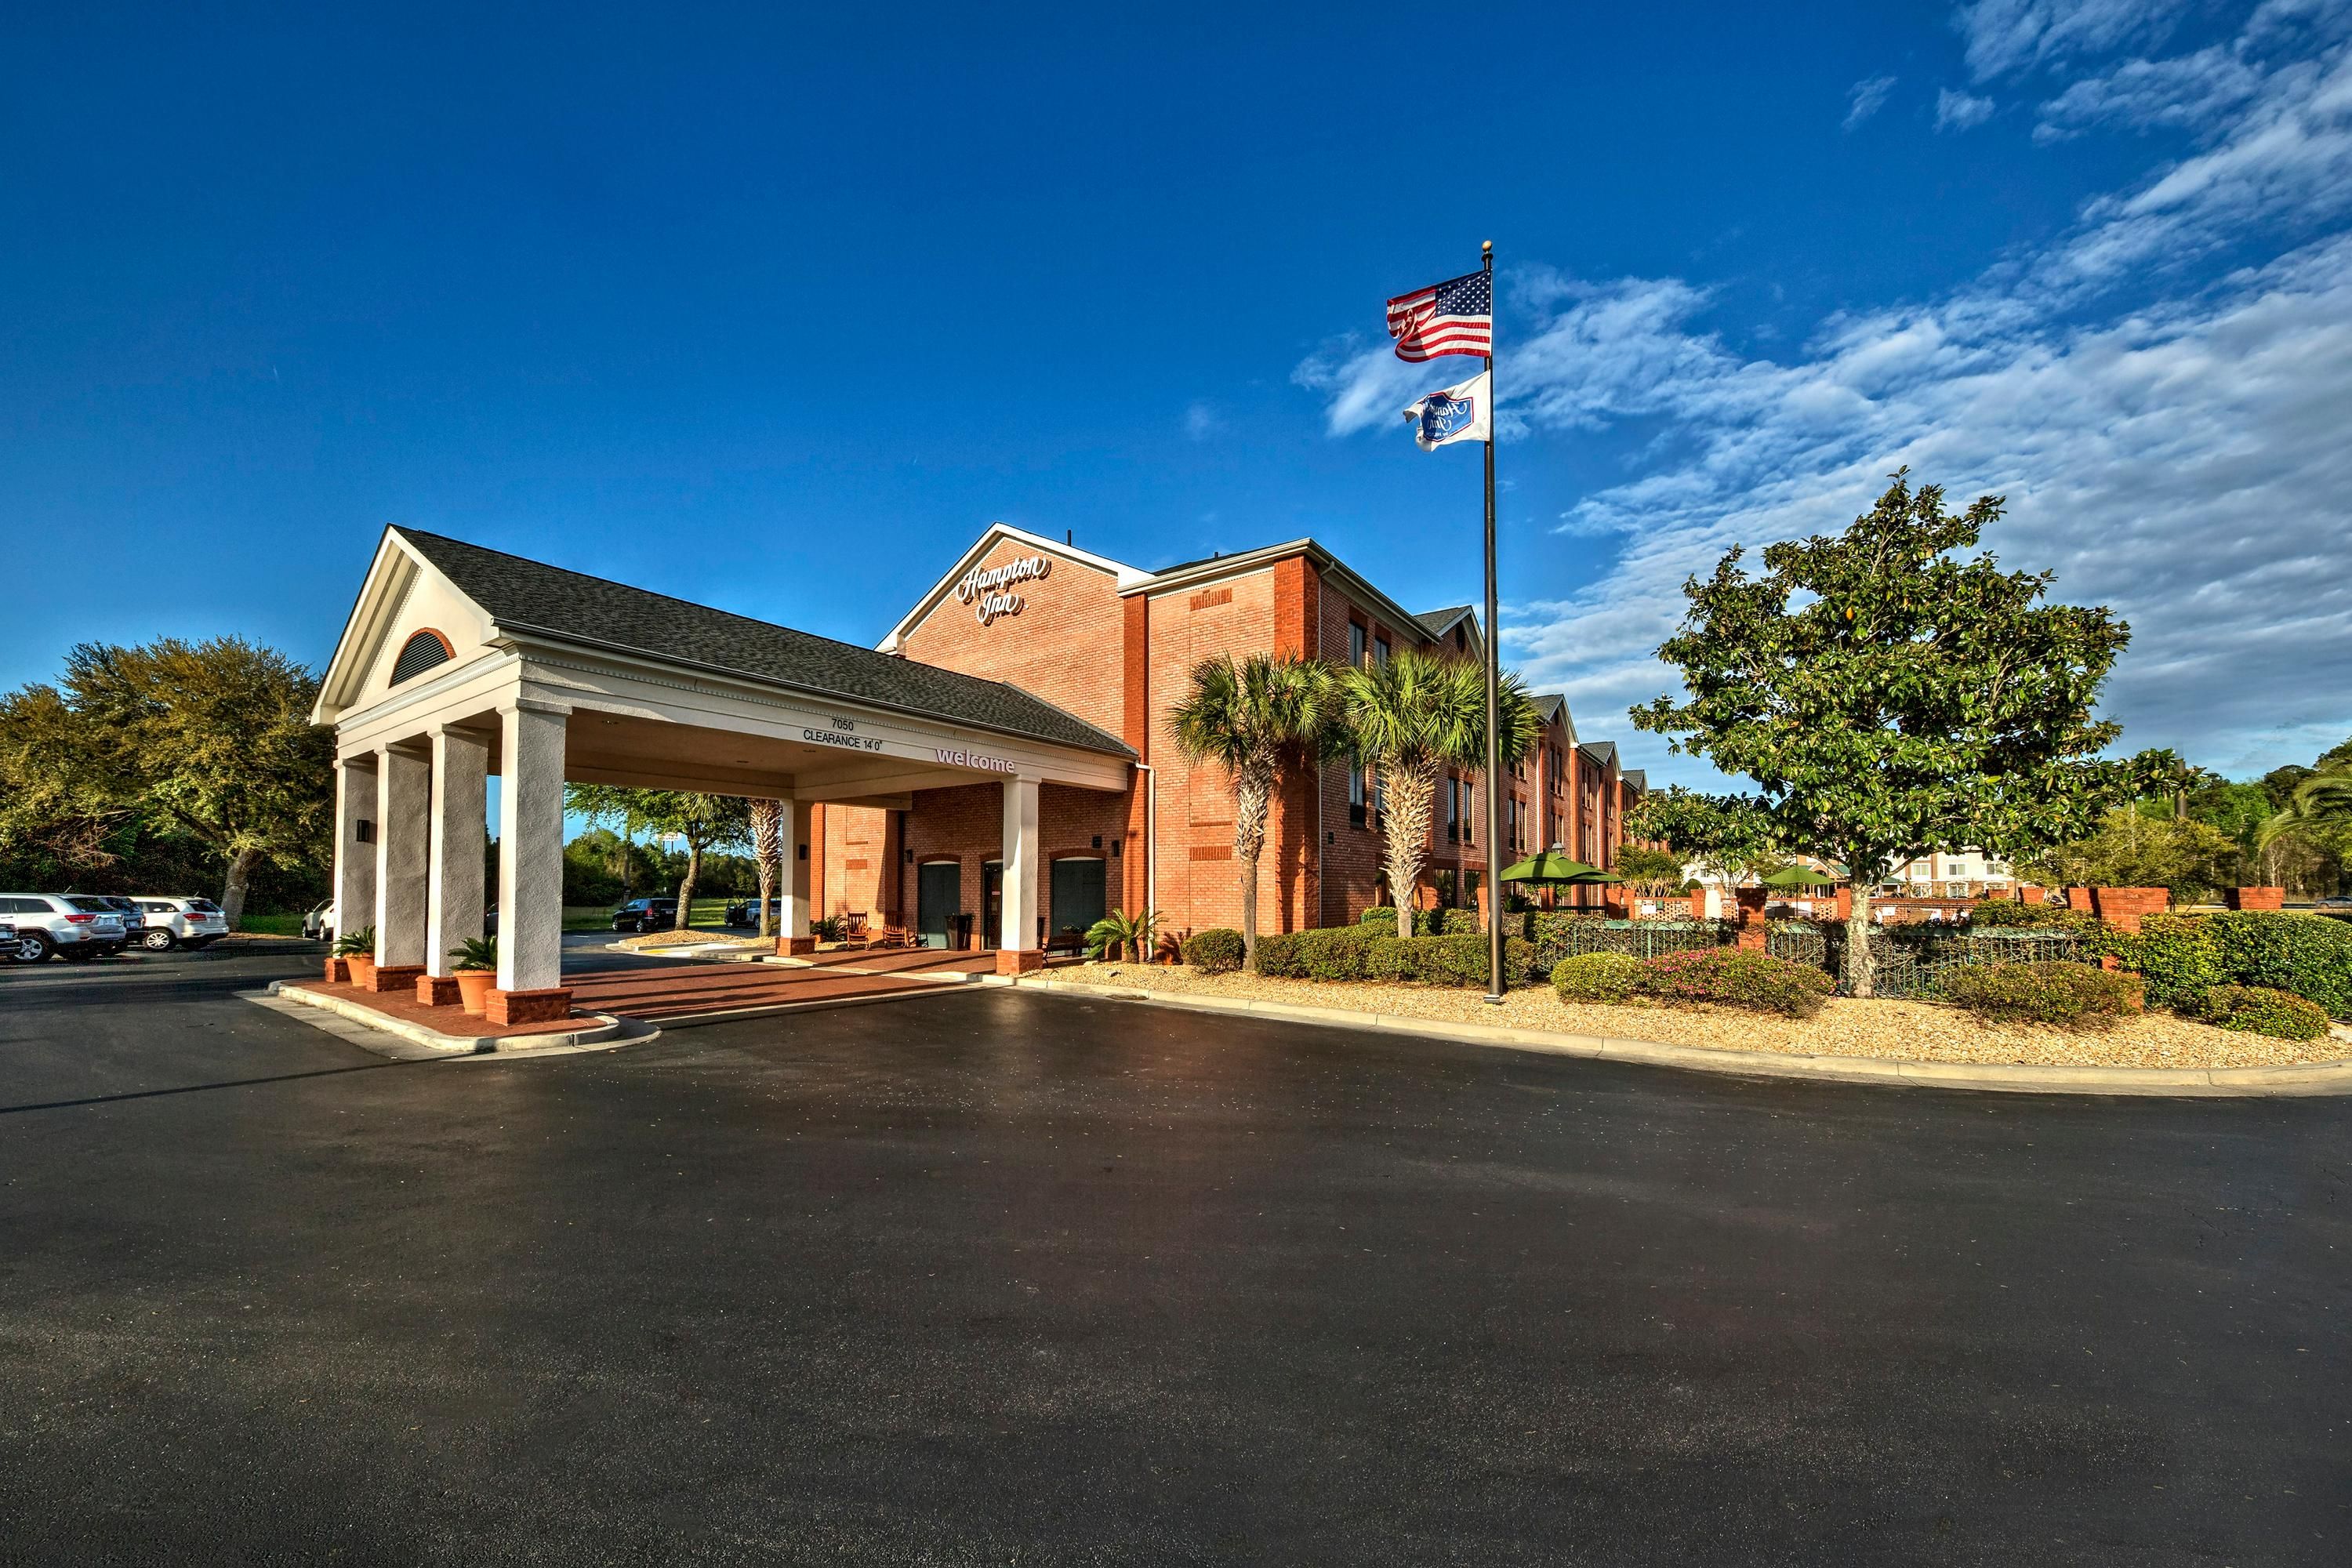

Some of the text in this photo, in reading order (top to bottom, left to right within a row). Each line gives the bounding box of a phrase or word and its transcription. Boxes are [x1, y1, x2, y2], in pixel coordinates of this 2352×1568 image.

[956, 557, 1051, 601] Hampton
[976, 591, 1022, 623] Inn
[832, 718, 854, 731] 7050
[804, 729, 860, 748] CLEARANCE
[936, 749, 1015, 773] welcome
